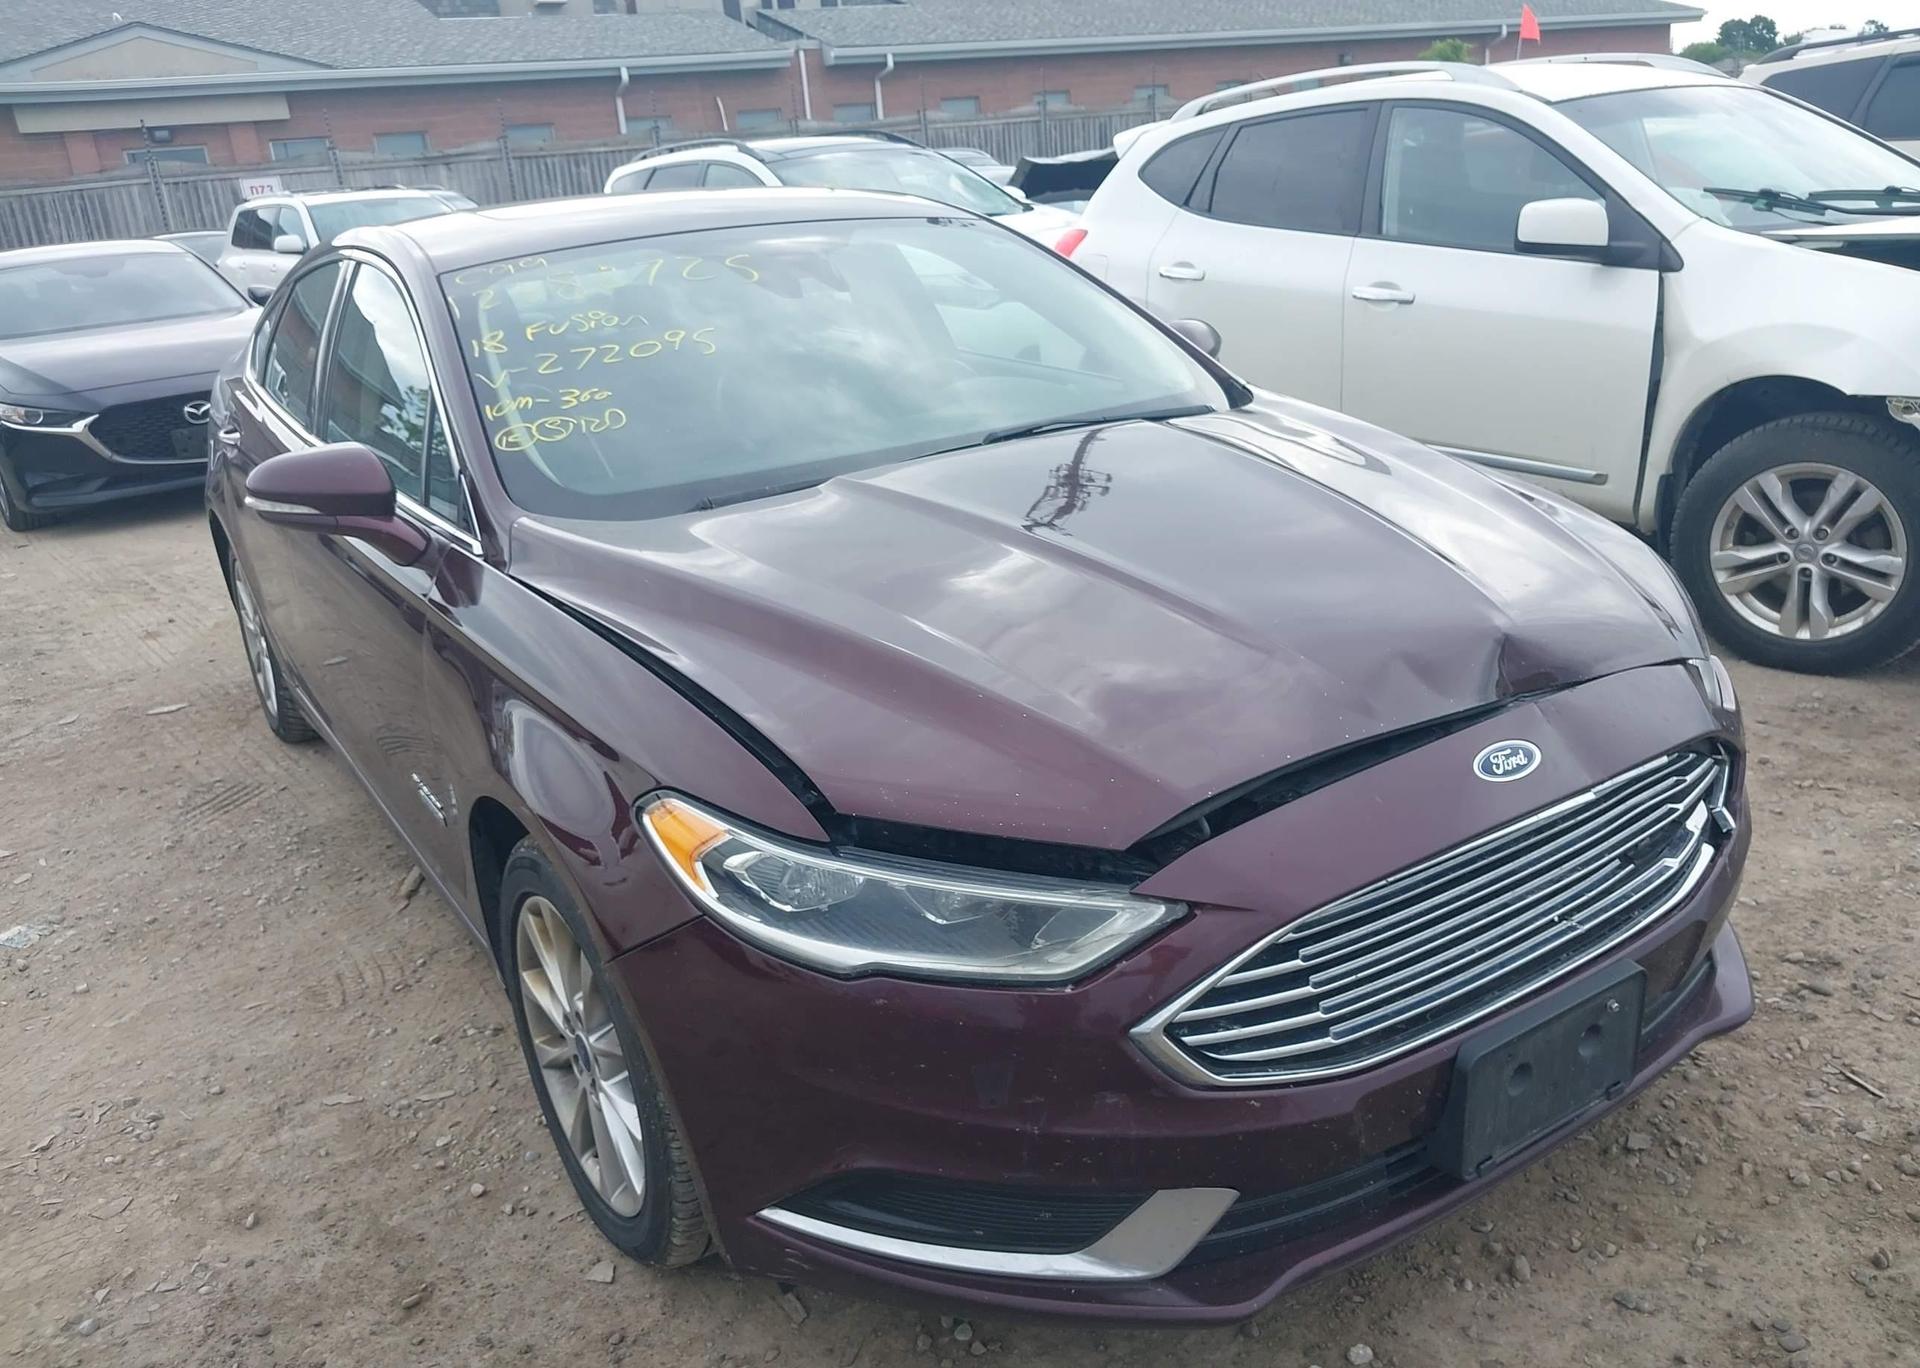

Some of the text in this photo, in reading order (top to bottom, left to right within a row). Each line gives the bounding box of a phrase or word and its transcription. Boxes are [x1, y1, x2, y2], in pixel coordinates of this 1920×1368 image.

[471, 310, 649, 357] 18 Fusion
[1489, 748, 1528, 775] Ford
